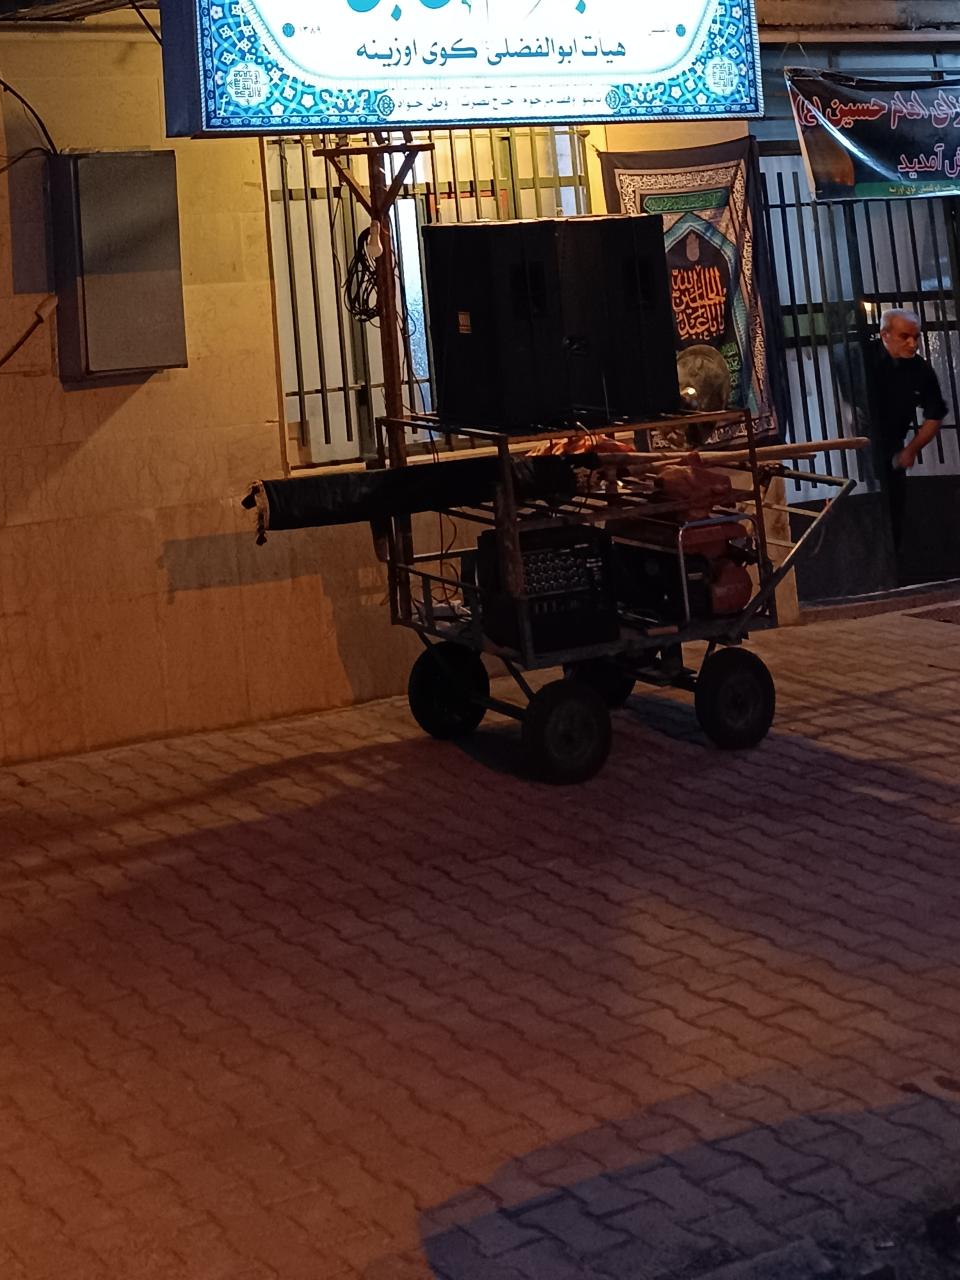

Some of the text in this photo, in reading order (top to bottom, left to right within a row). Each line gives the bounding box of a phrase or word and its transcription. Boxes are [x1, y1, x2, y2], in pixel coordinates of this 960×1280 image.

[356, 38, 418, 67] اوزینه
[422, 38, 478, 66] کوی
[487, 36, 577, 66] ابوالفضلی
[826, 98, 888, 128] حسین
[891, 90, 929, 129] امام
[898, 142, 945, 178] آمدید
